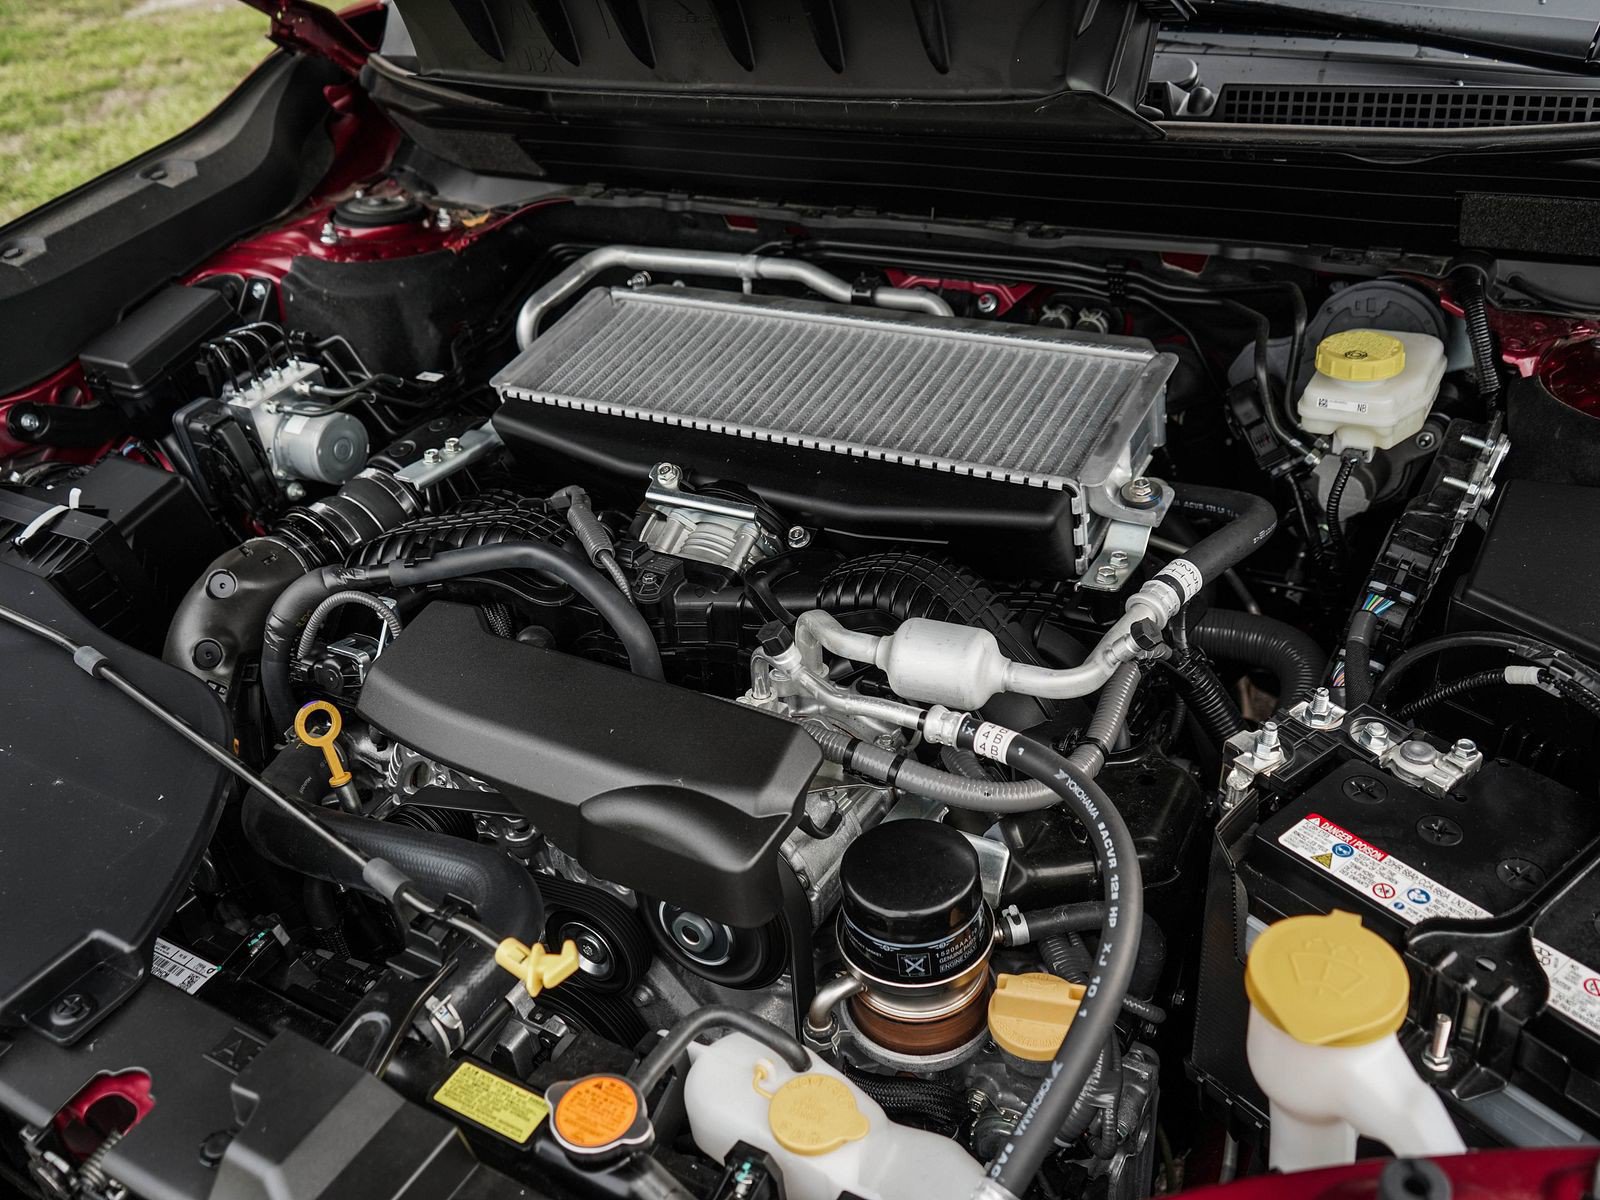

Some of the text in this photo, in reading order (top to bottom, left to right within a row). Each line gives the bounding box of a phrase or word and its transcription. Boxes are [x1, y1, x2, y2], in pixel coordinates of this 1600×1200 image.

[1065, 779, 1099, 820] YOKOHAMA
[1320, 821, 1352, 843] DANGER
[1354, 840, 1385, 861] POISON
[1108, 906, 1119, 928] HP
[1013, 1077, 1054, 1136] YOKOHAMA
